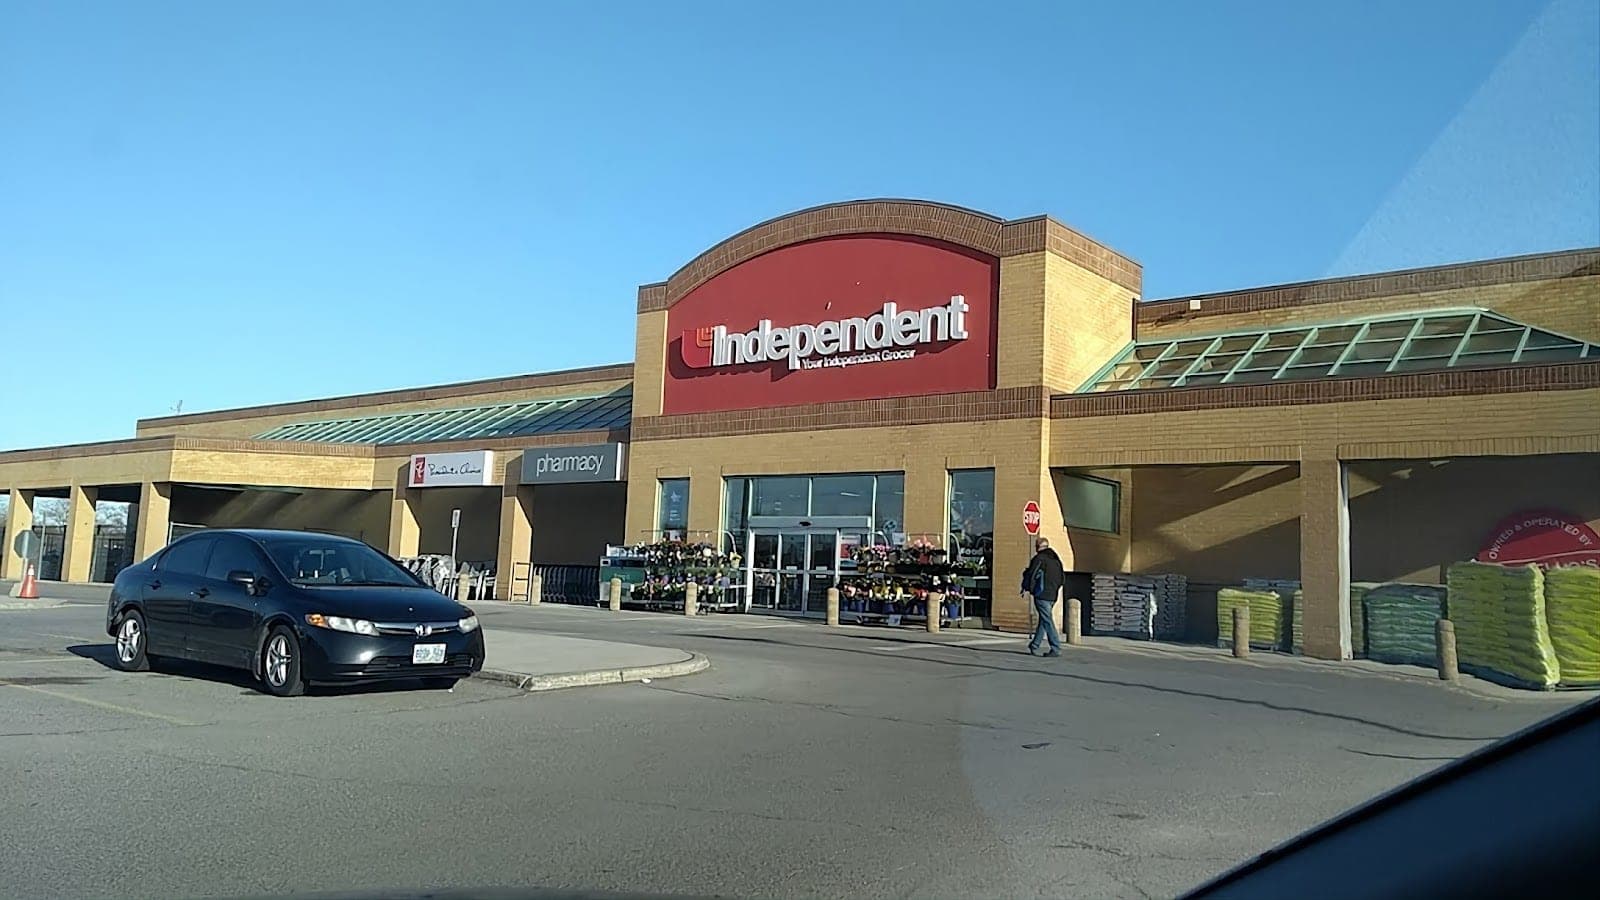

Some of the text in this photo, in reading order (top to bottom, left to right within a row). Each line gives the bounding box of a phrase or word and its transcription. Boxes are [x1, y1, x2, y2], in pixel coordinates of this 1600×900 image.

[713, 295, 969, 370] Independent
[802, 349, 916, 370] Your Independent Grocer
[537, 453, 604, 475] pharmacy
[1024, 510, 1040, 525] STOP
[1488, 528, 1514, 560] OWNED
[1523, 517, 1580, 536] OPERATED
[1579, 534, 1593, 546] BY
